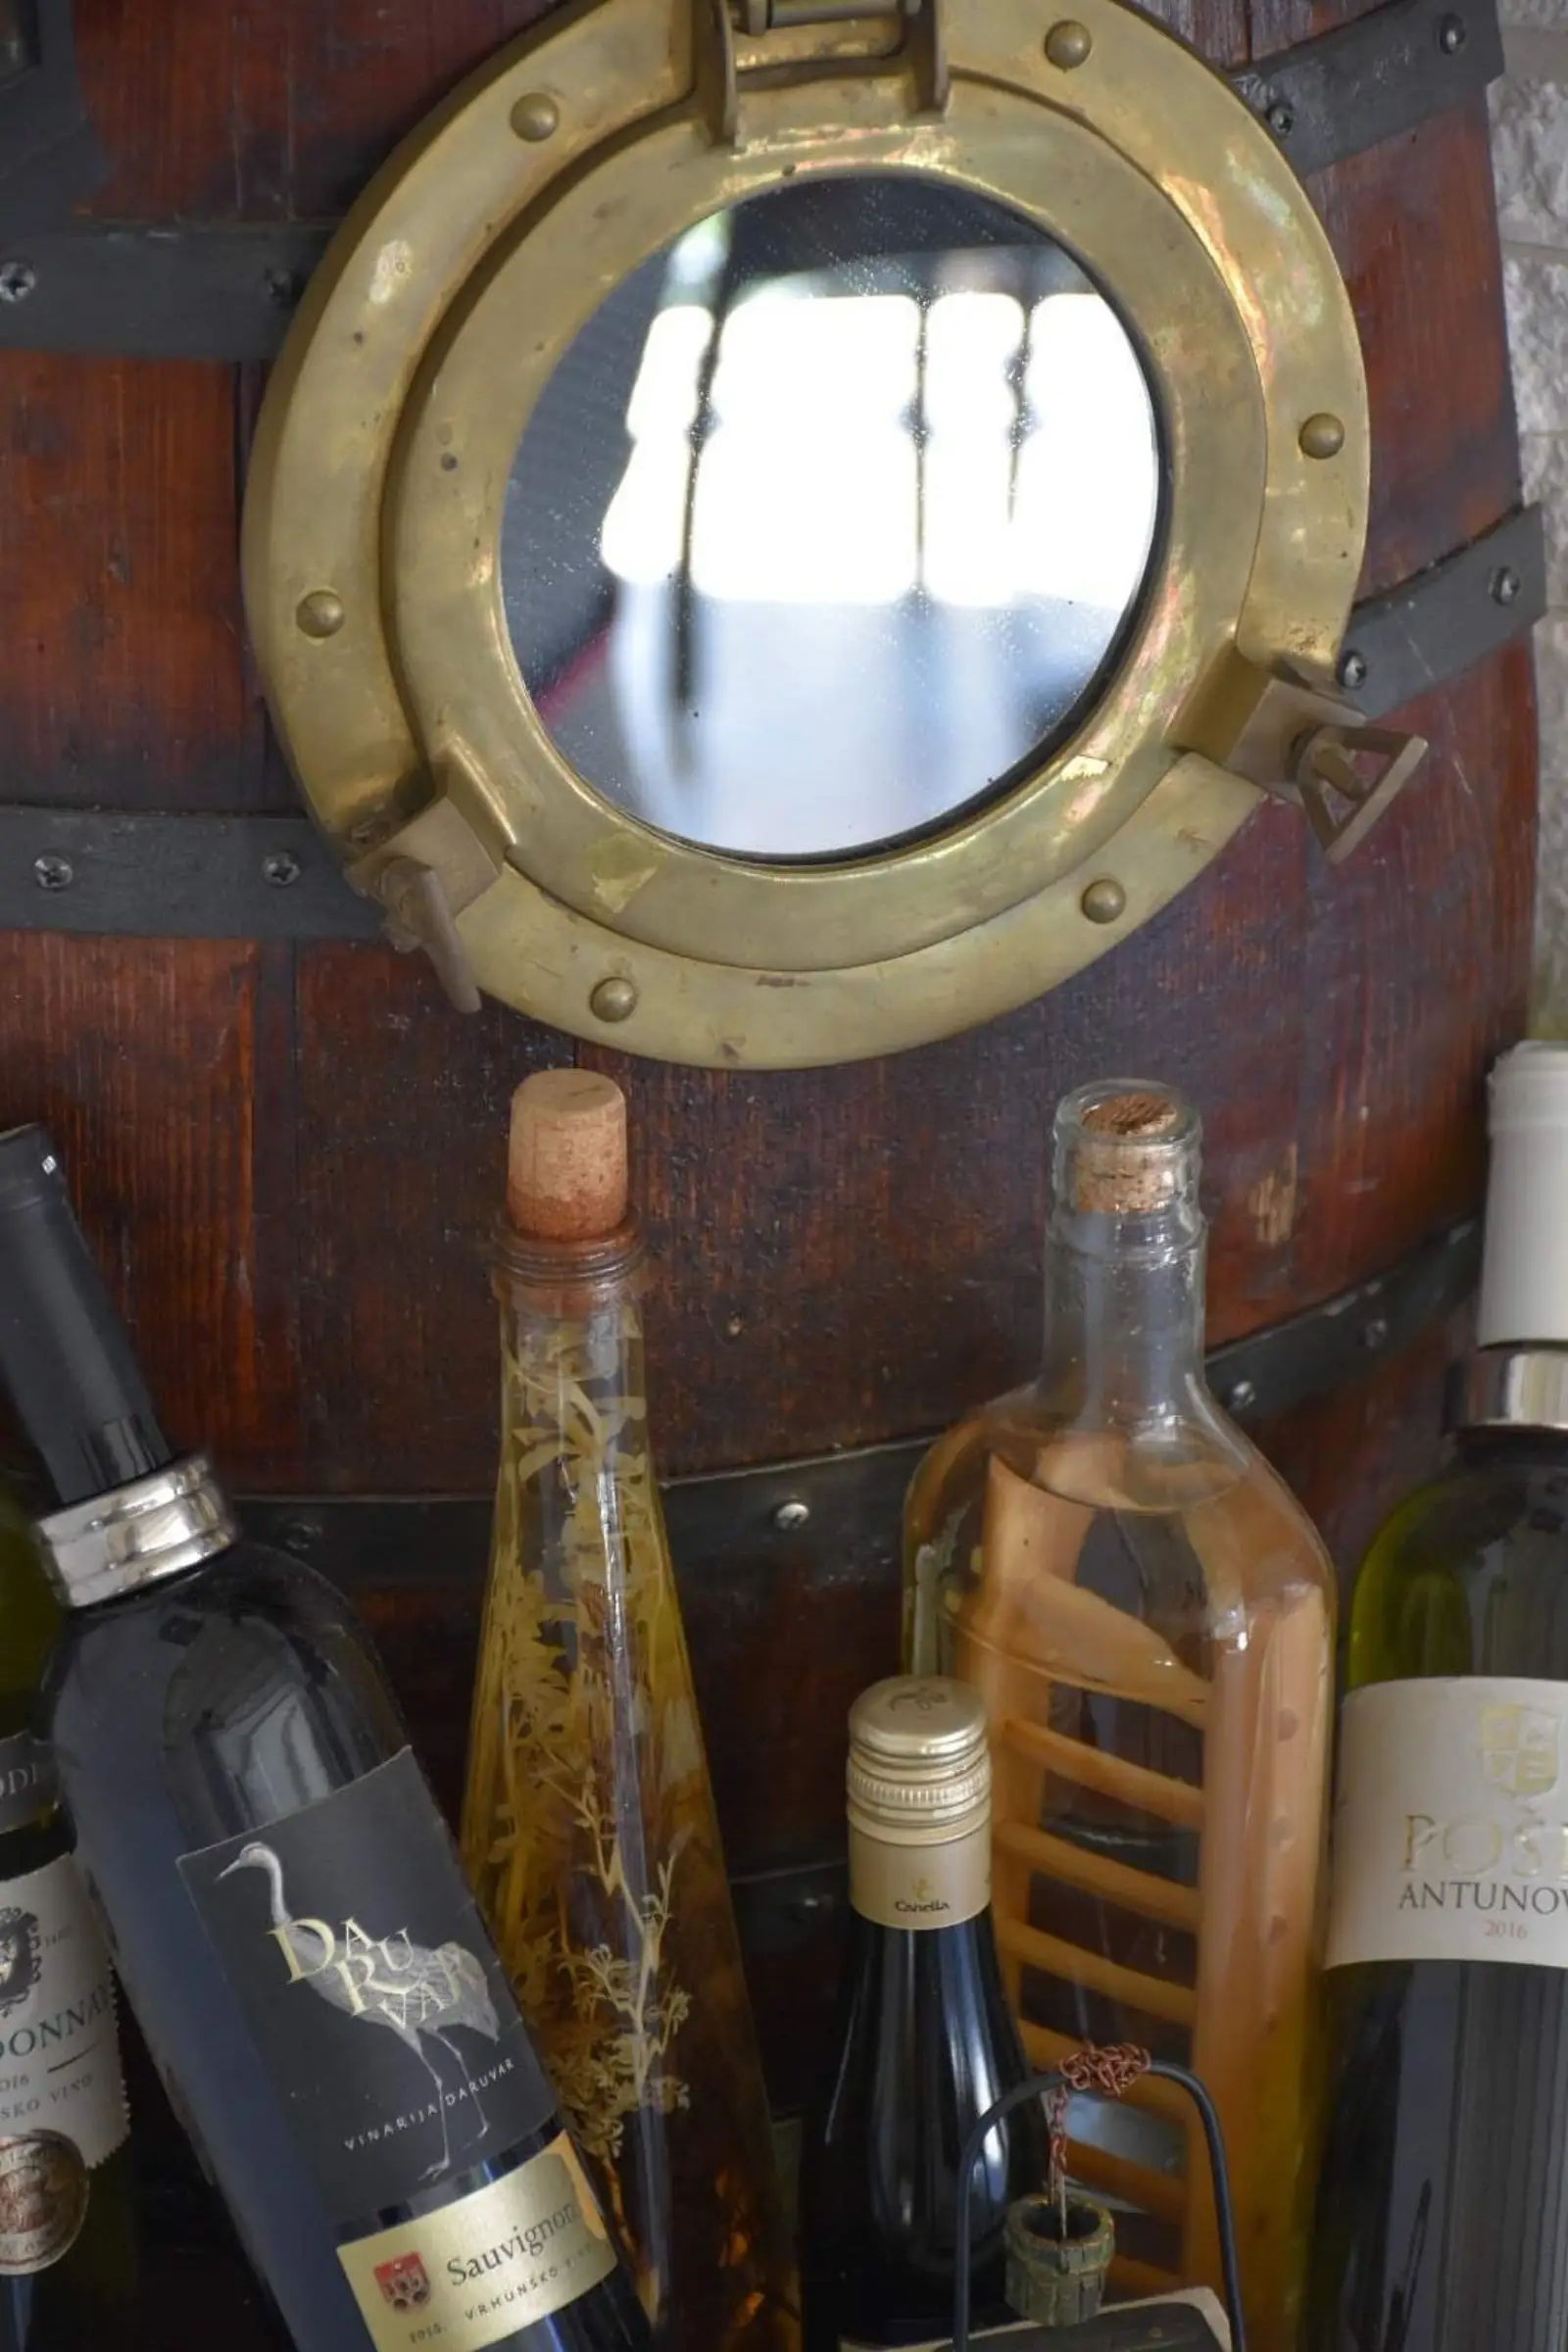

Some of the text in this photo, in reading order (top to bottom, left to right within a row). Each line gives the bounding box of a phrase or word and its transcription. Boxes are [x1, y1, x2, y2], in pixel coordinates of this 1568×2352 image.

[1484, 1919, 1528, 1939] 2016
[344, 2057, 514, 2151] VINARIJA DARUVAR
[446, 2202, 577, 2286] Sauvignon
[464, 2267, 561, 2321] VRHUNSKO
